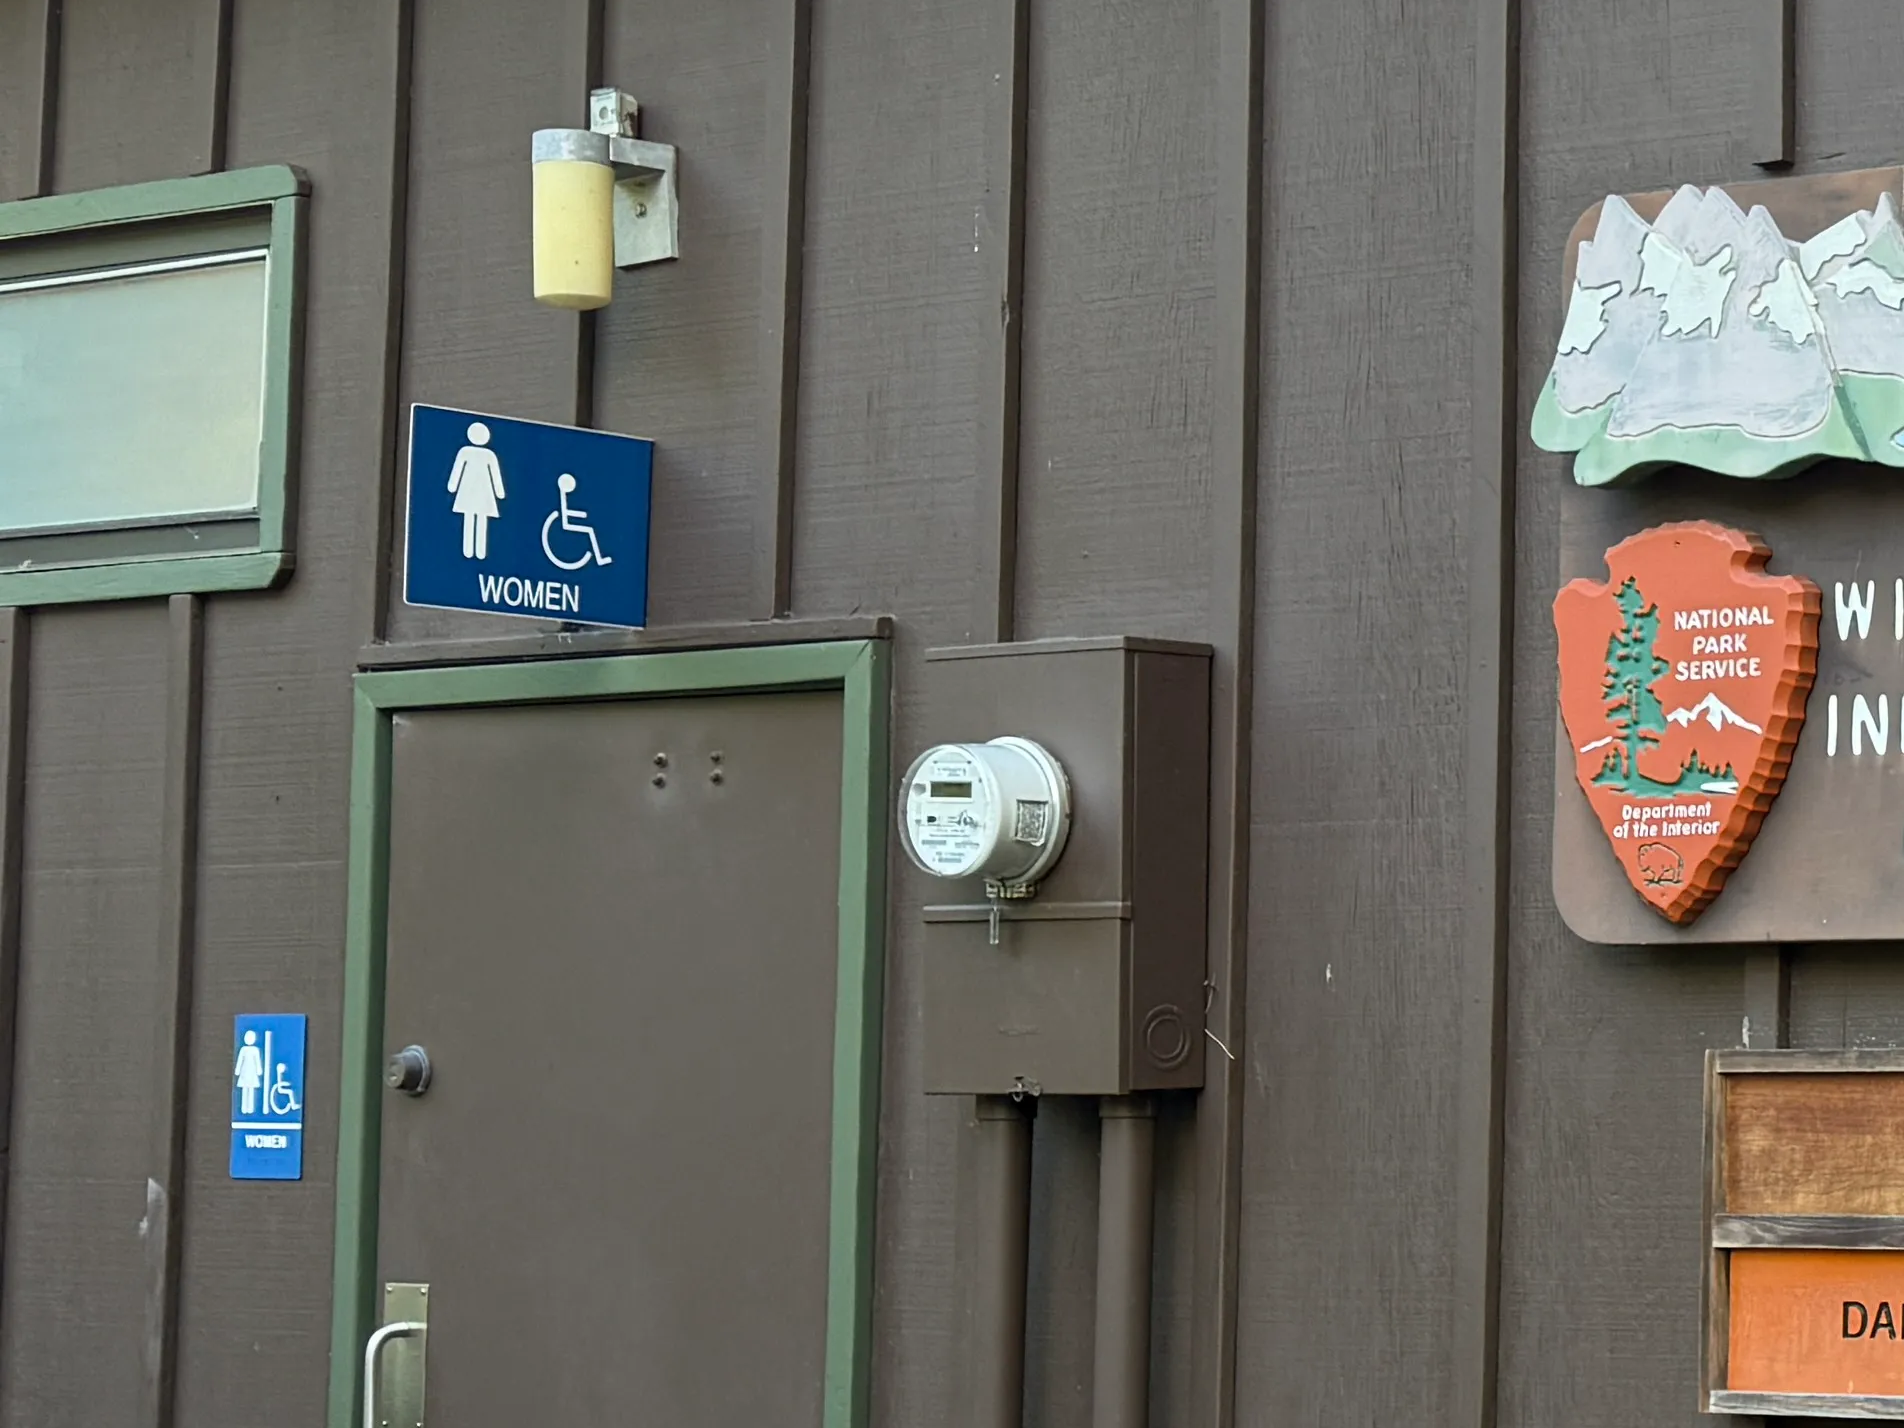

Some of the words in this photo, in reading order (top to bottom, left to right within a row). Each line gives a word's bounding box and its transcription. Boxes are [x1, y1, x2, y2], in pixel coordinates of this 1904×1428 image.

[478, 573, 580, 613] WOMEN
[1673, 605, 1775, 631] NATIONAL
[1691, 632, 1748, 655] PARK
[1674, 657, 1762, 682] SERVICE
[1622, 801, 1712, 821] Department
[1612, 824, 1629, 839] of
[1632, 822, 1659, 837] the
[1662, 820, 1721, 836] Interior
[244, 1133, 288, 1149] WOMEN
